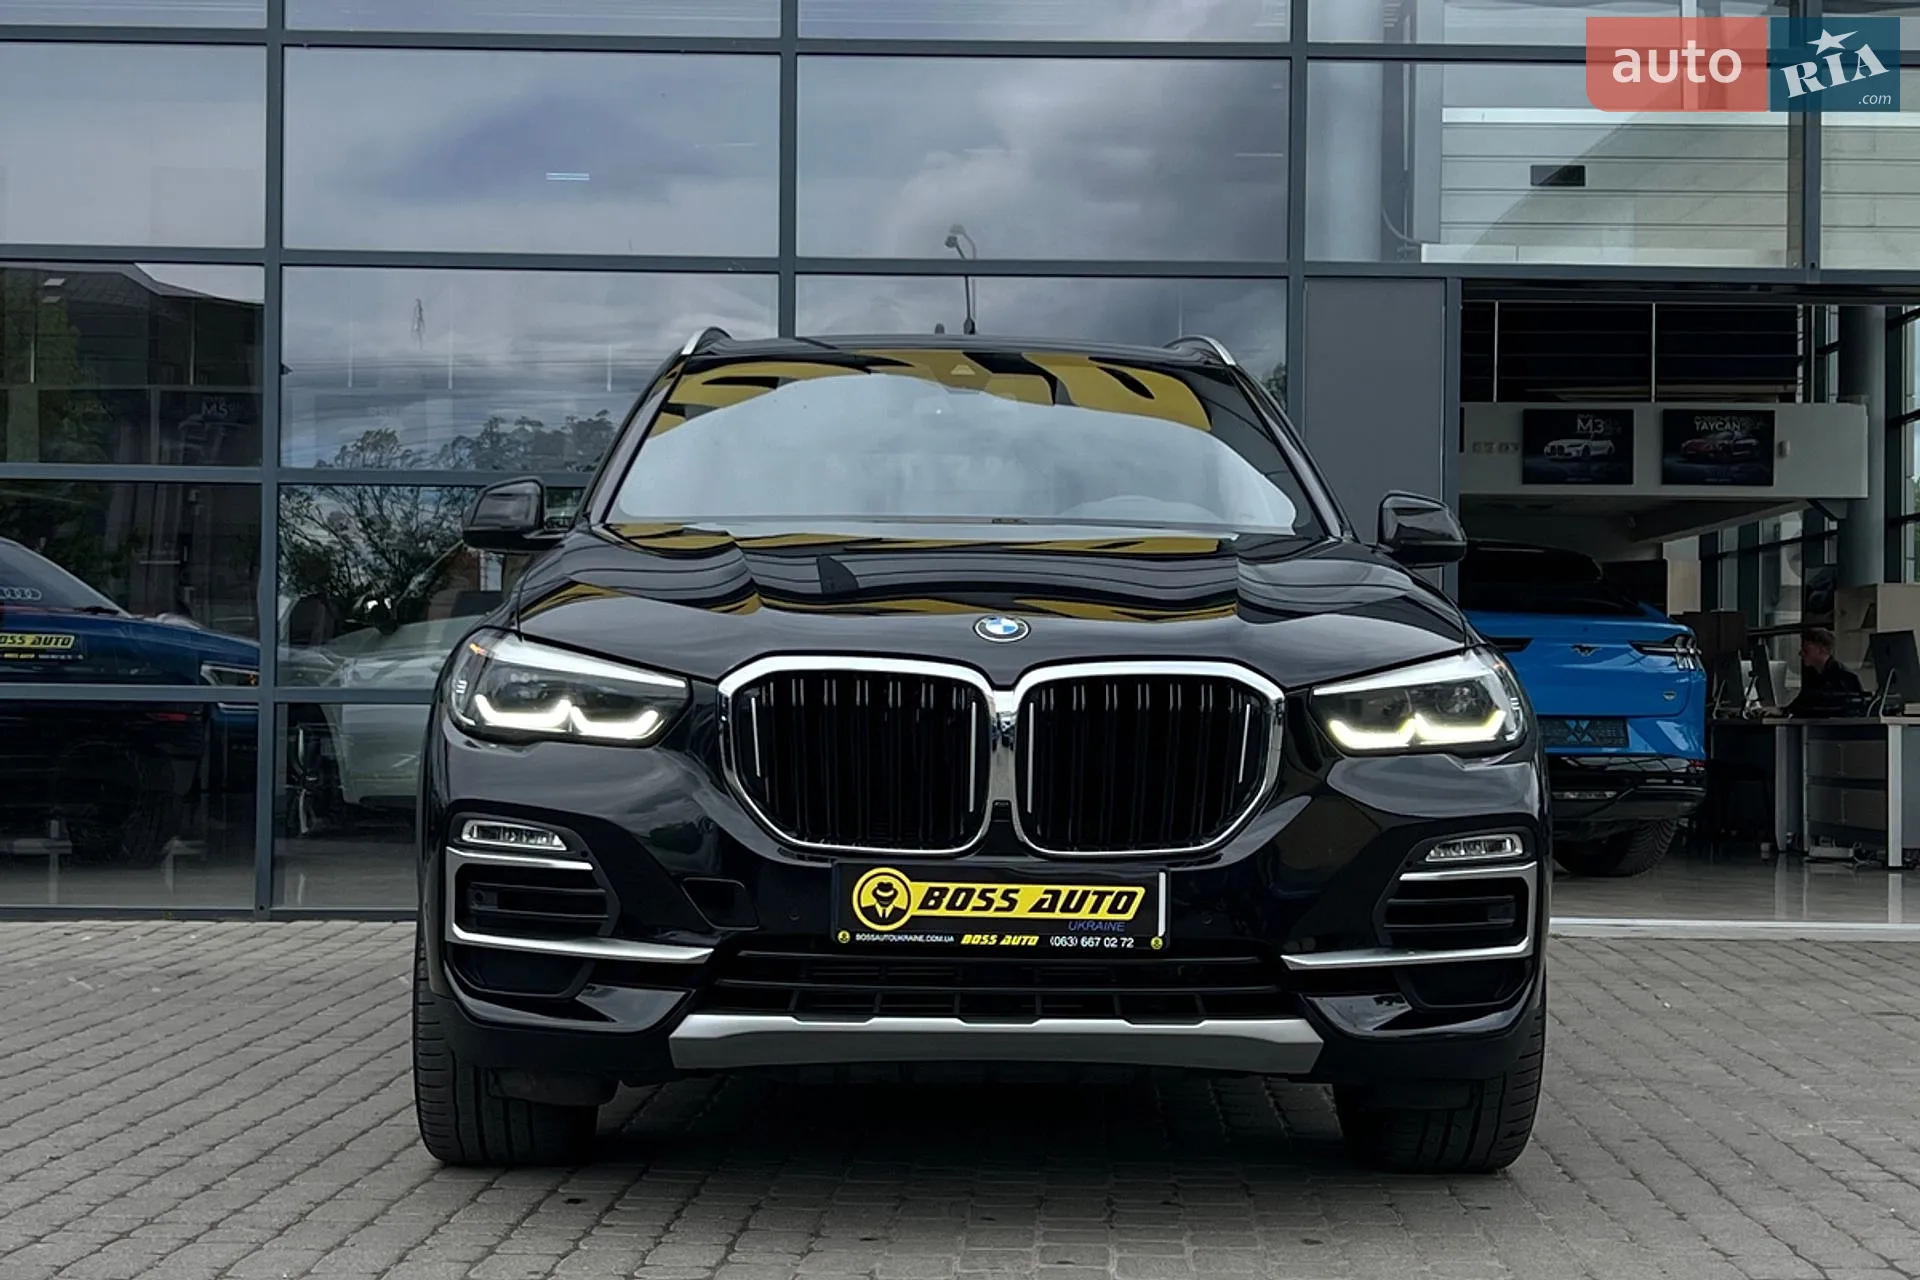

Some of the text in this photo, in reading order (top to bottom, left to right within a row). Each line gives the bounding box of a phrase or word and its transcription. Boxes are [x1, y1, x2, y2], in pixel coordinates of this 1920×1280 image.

[1577, 418, 1605, 434] M3
[1694, 422, 1741, 432] TAYCAN
[31, 636, 72, 646] AUTO
[917, 886, 1138, 915] BOSS AUTO
[1067, 920, 1126, 933] UKRAINE
[855, 933, 1134, 948] BOSSAUTOUKRAINE.COM.UA BOSS AUTO (063) 667 02 72
